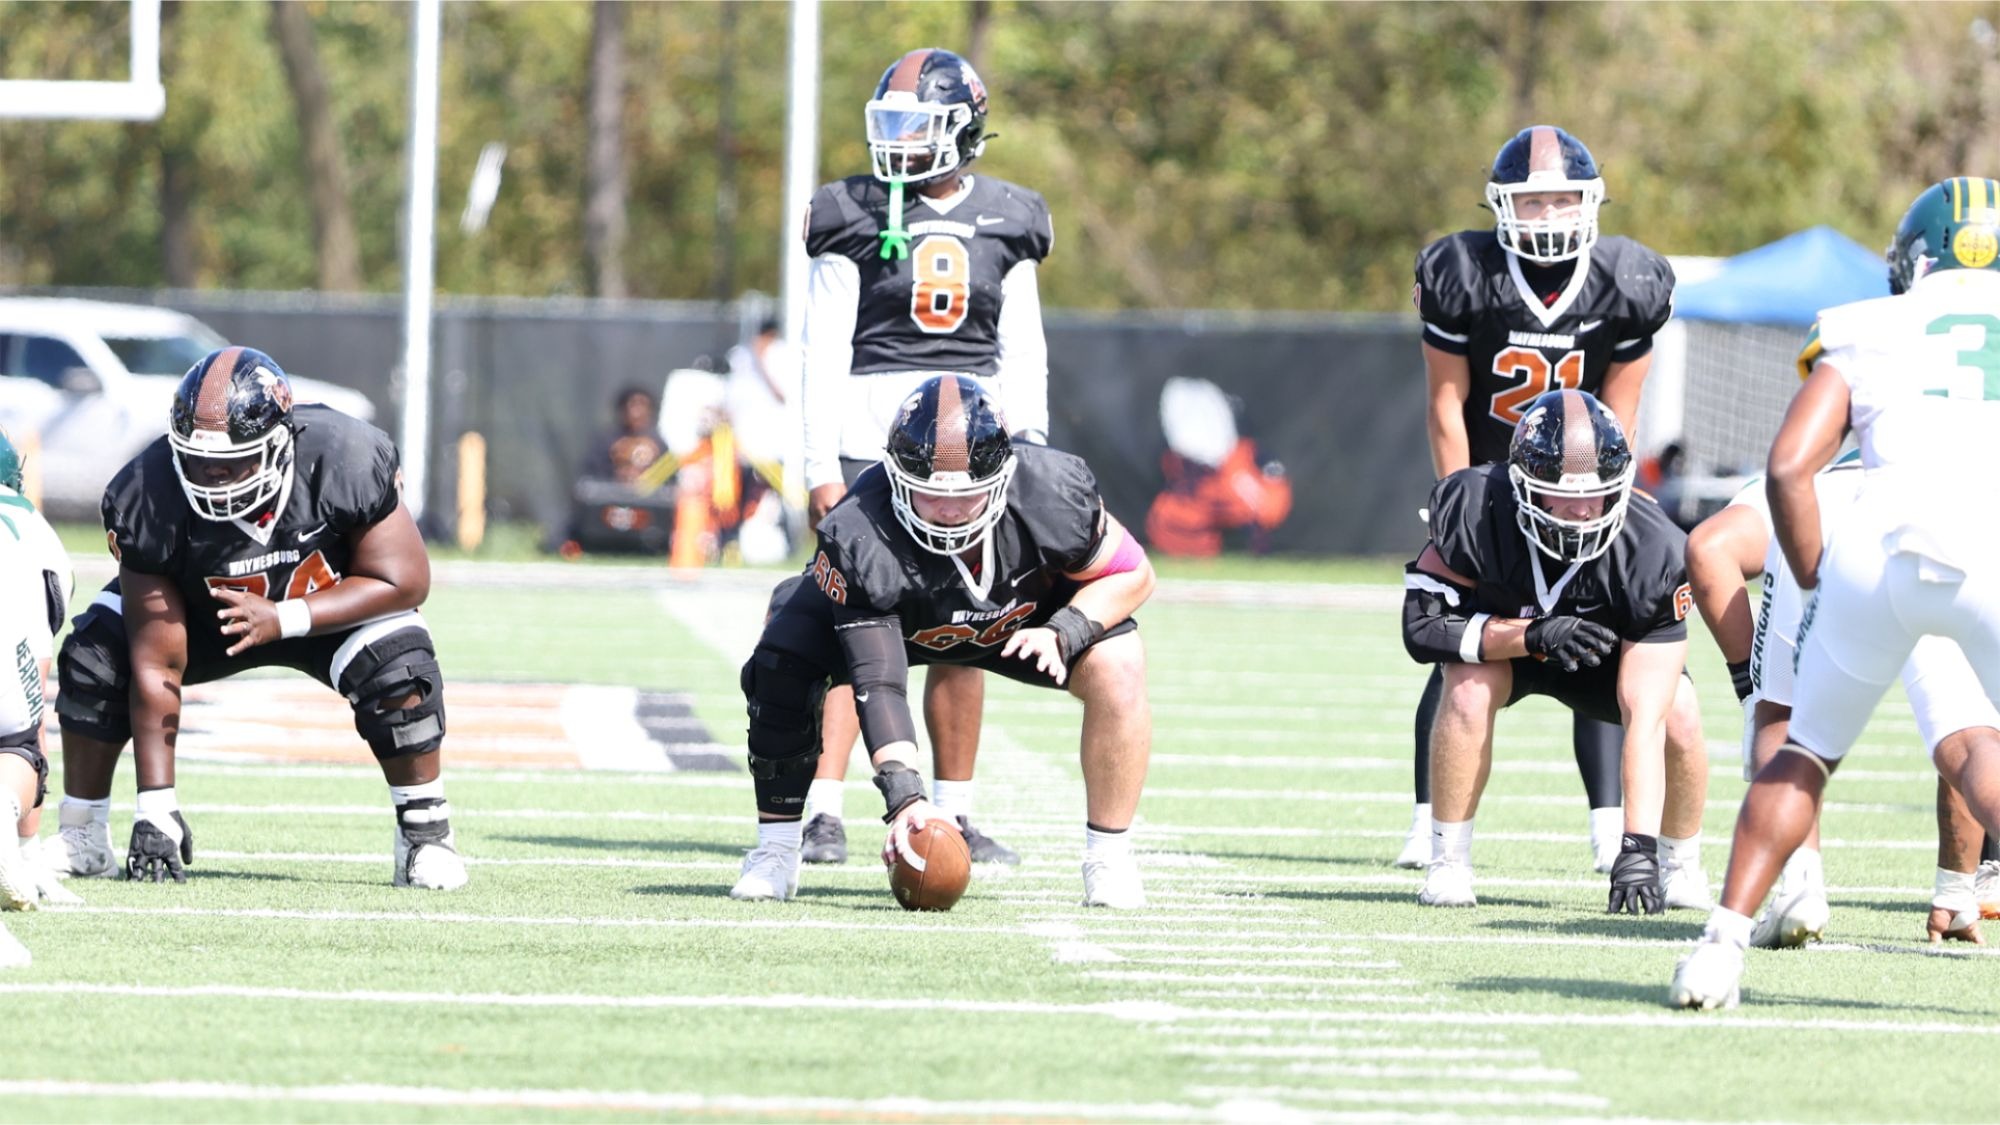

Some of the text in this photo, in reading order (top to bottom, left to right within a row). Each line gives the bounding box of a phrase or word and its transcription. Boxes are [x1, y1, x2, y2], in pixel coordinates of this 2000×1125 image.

[911, 234, 970, 333] 8
[1489, 346, 1585, 427] 21
[228, 549, 301, 577] WAYNESBURG
[812, 550, 848, 606] 66
[1751, 571, 1775, 690] BEARCATS
